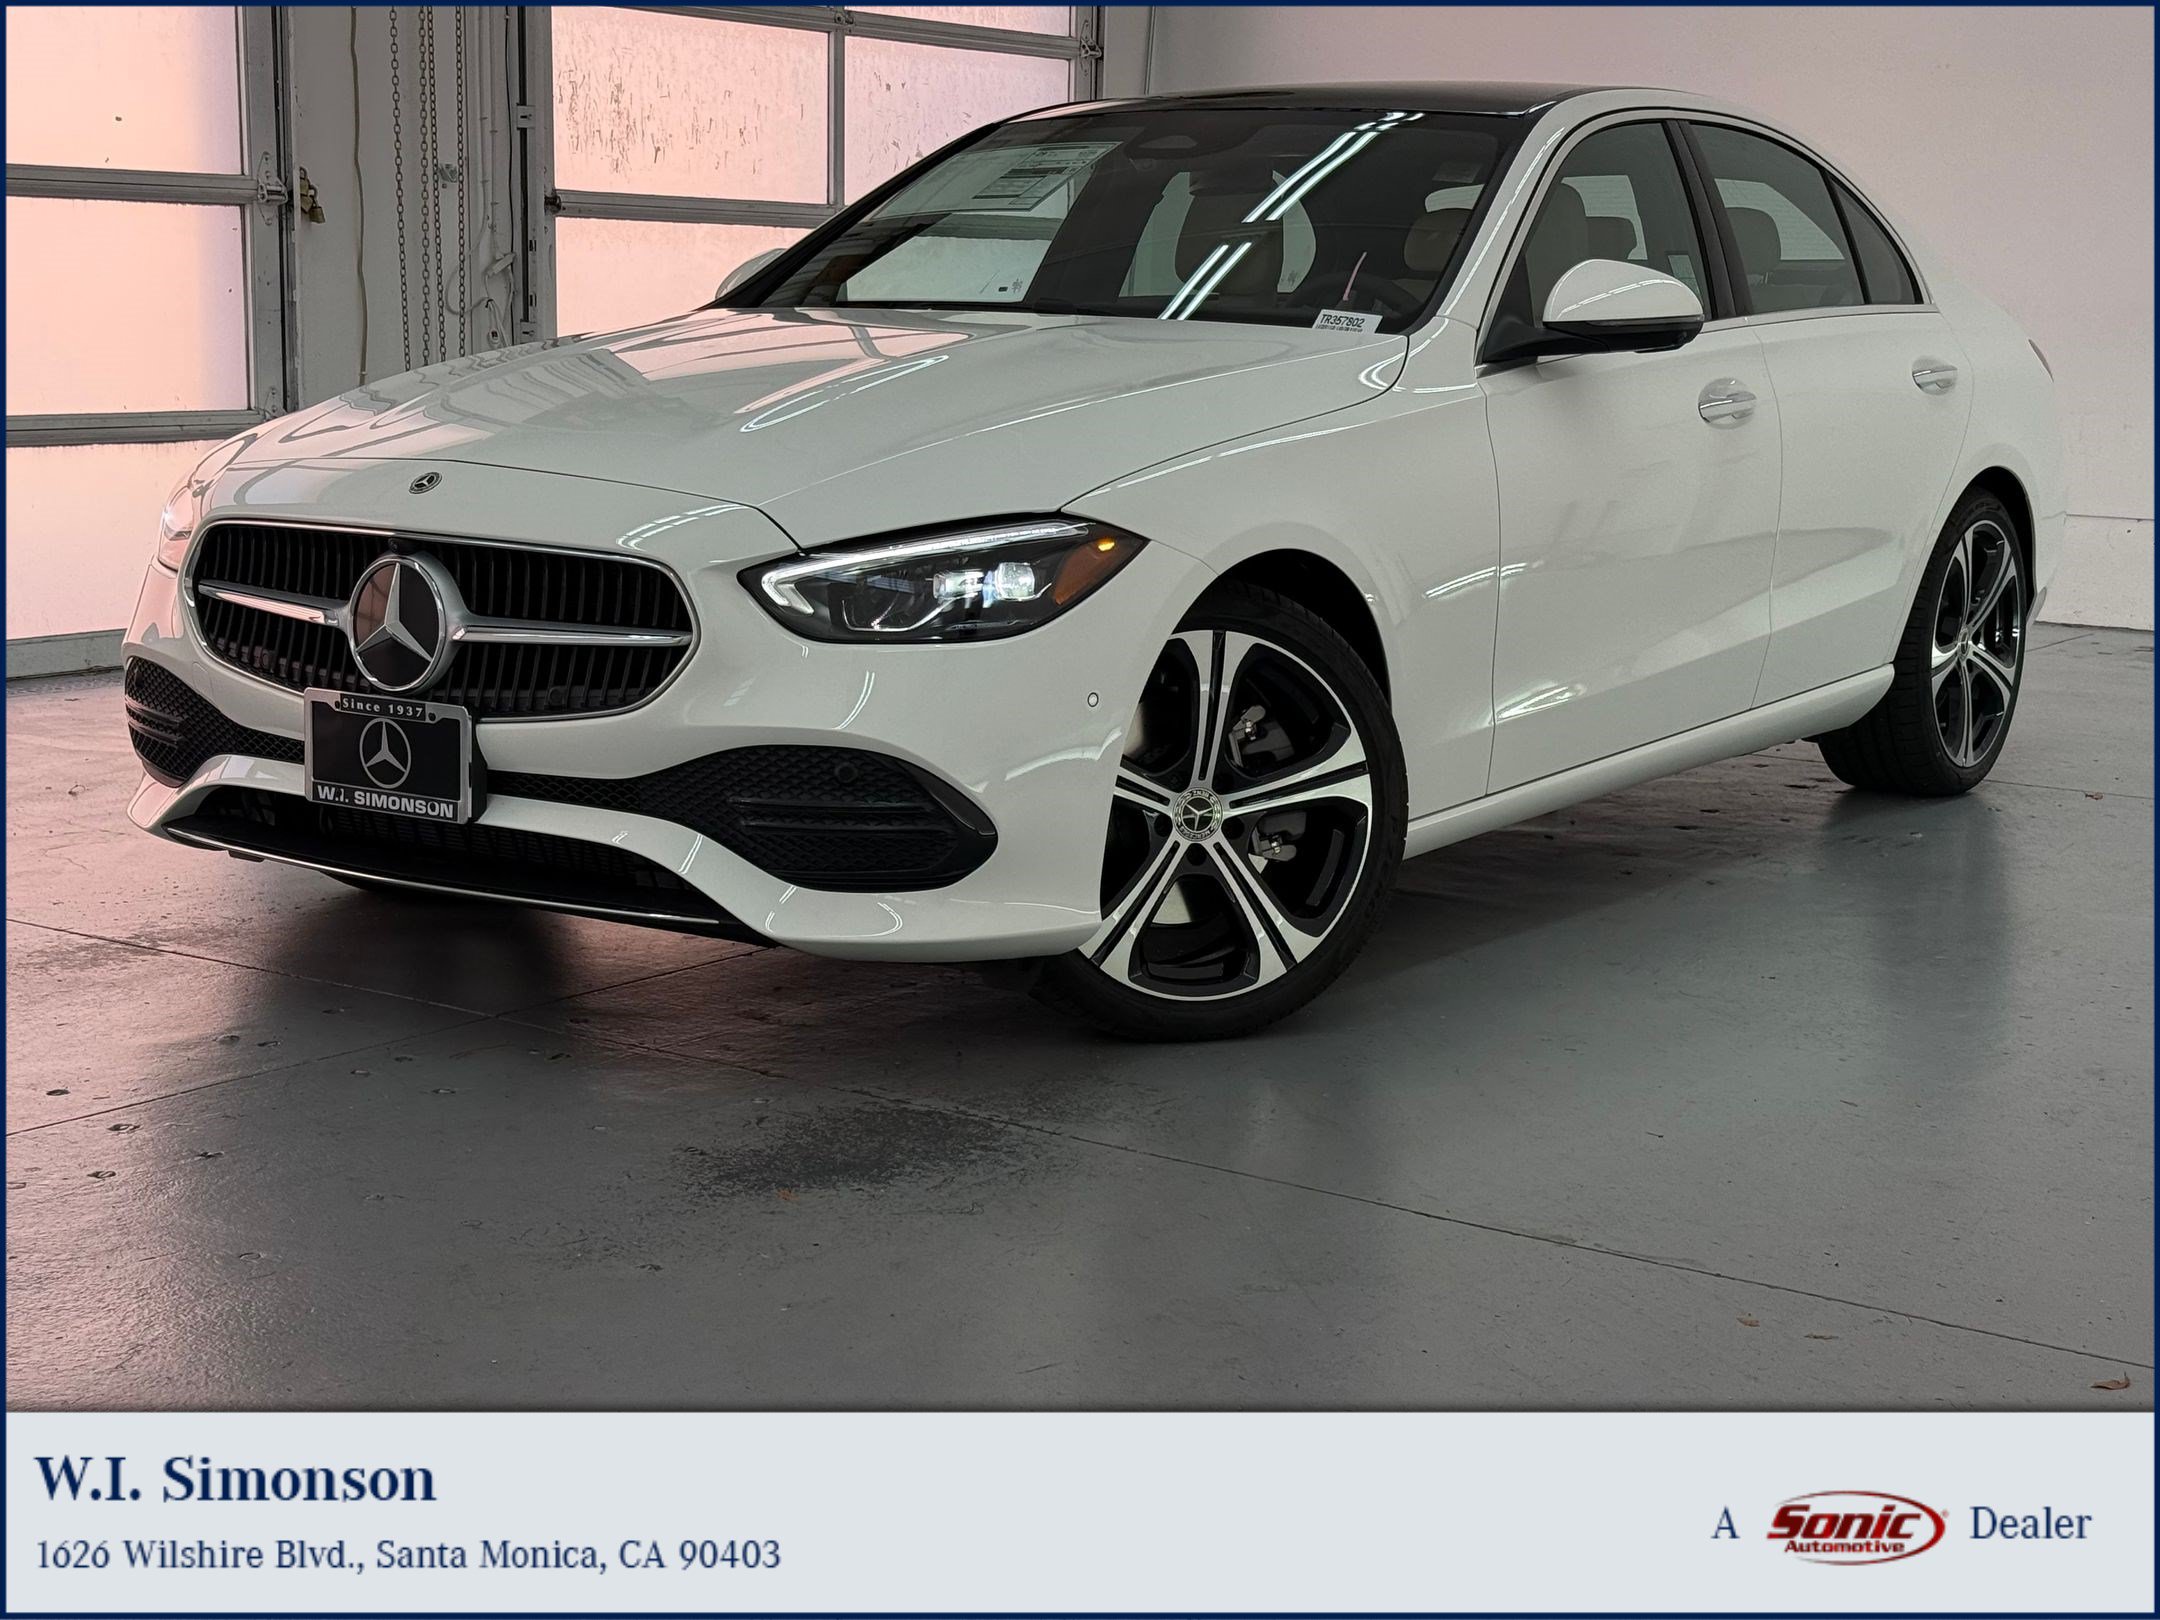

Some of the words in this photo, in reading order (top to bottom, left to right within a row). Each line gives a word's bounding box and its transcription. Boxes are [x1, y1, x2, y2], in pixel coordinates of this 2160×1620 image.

[1320, 314, 1365, 327] TR357802
[341, 698, 381, 712] Since
[388, 703, 423, 718] 1937
[317, 785, 349, 803] W.I.
[354, 791, 453, 818] SIMONSON
